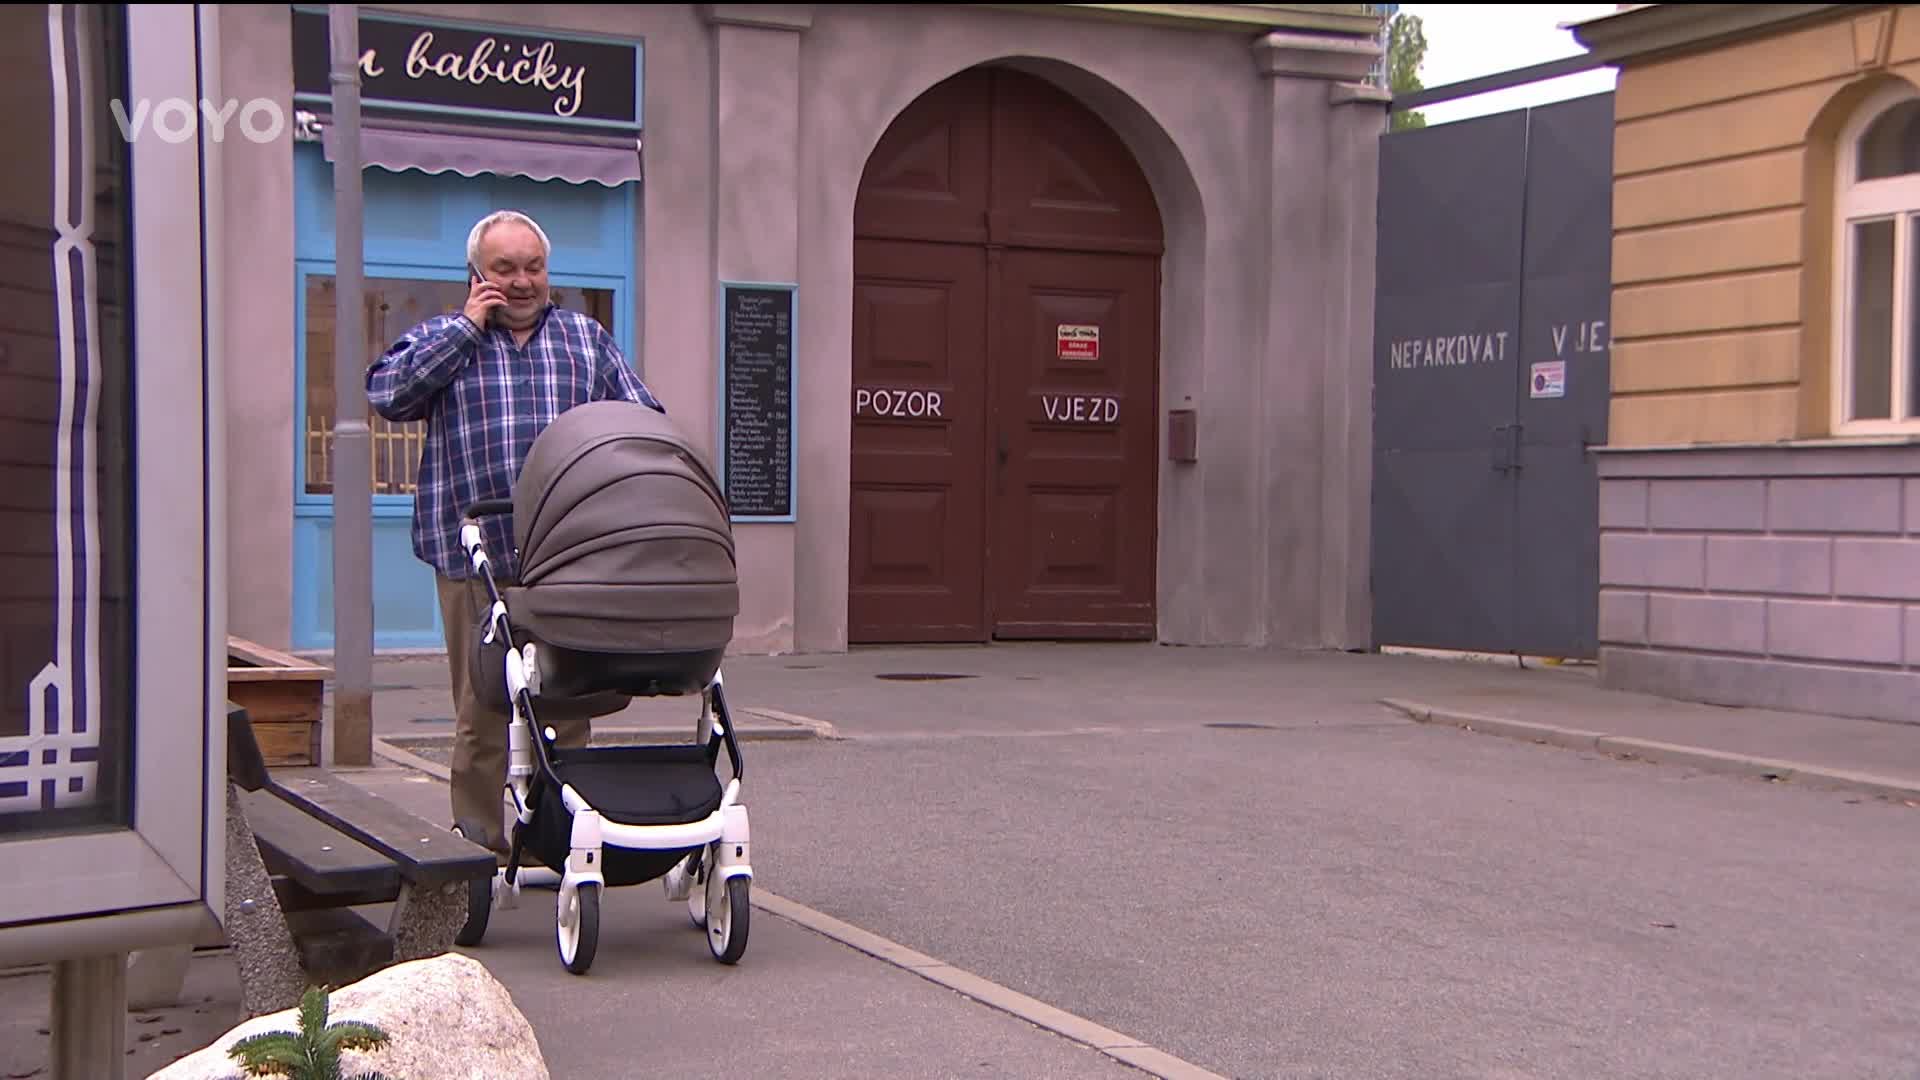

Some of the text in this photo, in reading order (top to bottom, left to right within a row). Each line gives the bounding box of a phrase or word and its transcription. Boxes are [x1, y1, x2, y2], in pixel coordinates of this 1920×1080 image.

[406, 31, 585, 117] babičky
[1391, 331, 1508, 369] NEPARKOVAT
[1552, 321, 1605, 356] VJE
[855, 390, 942, 417] POZOR
[1042, 396, 1119, 422] VJEZD
